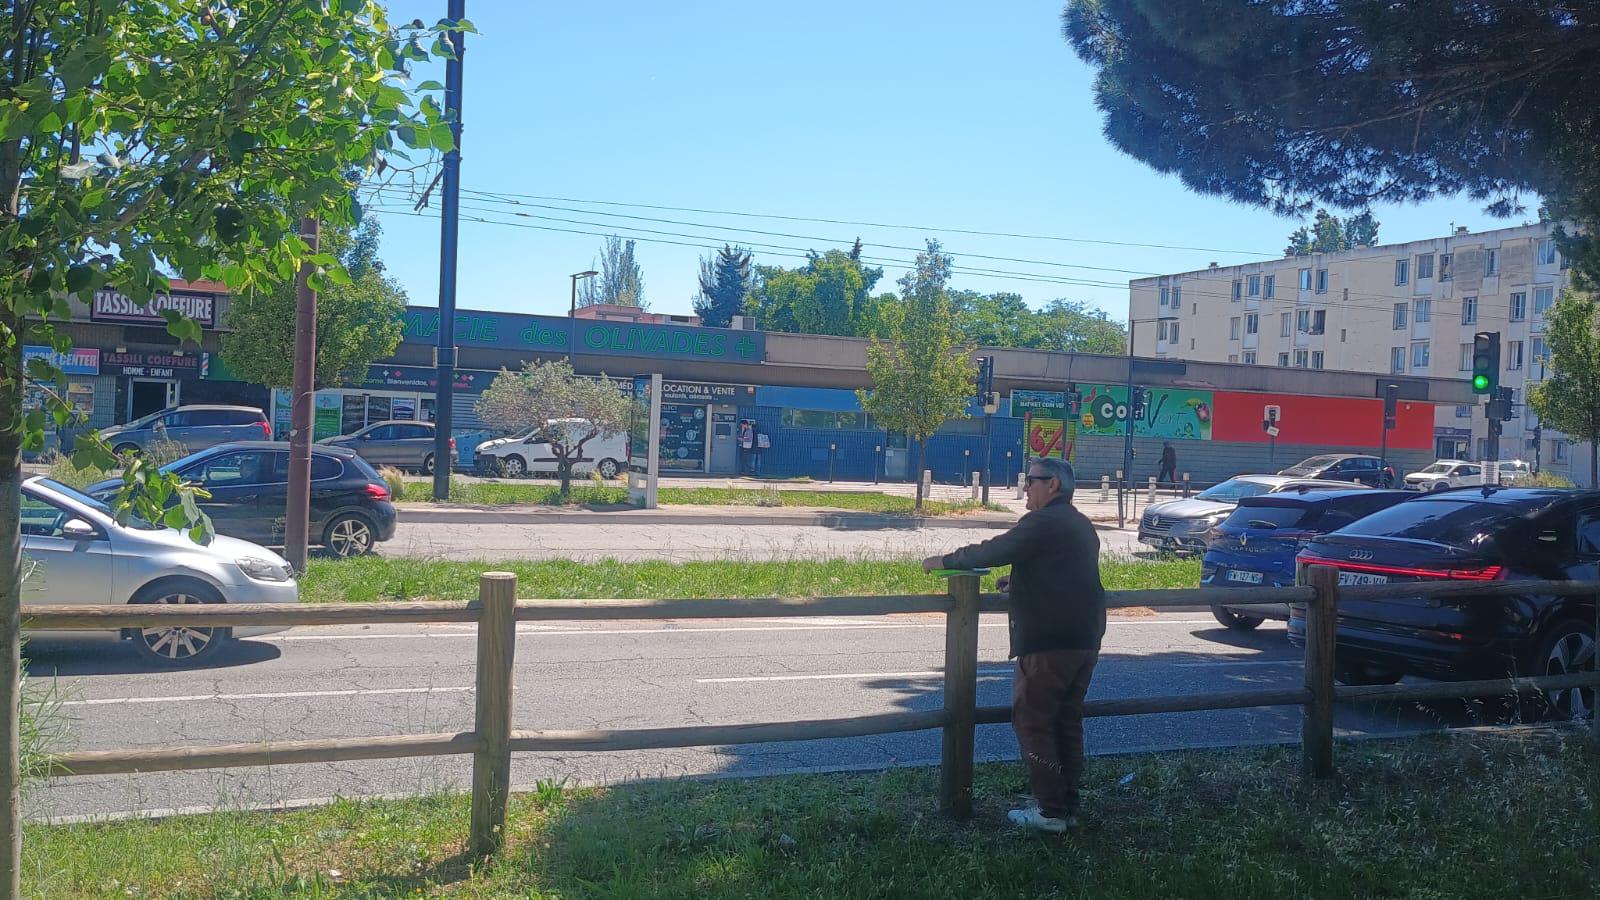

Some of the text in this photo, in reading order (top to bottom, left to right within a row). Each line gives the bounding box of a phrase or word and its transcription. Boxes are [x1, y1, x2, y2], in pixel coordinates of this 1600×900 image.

[520, 320, 568, 346] des
[585, 325, 728, 356] OLIVADES
[103, 352, 198, 367] TASSILI COIFFURE
[123, 366, 145, 376] HOMME
[150, 368, 173, 377] ENFANT
[703, 386, 710, 394] &
[711, 386, 736, 396] VENTE
